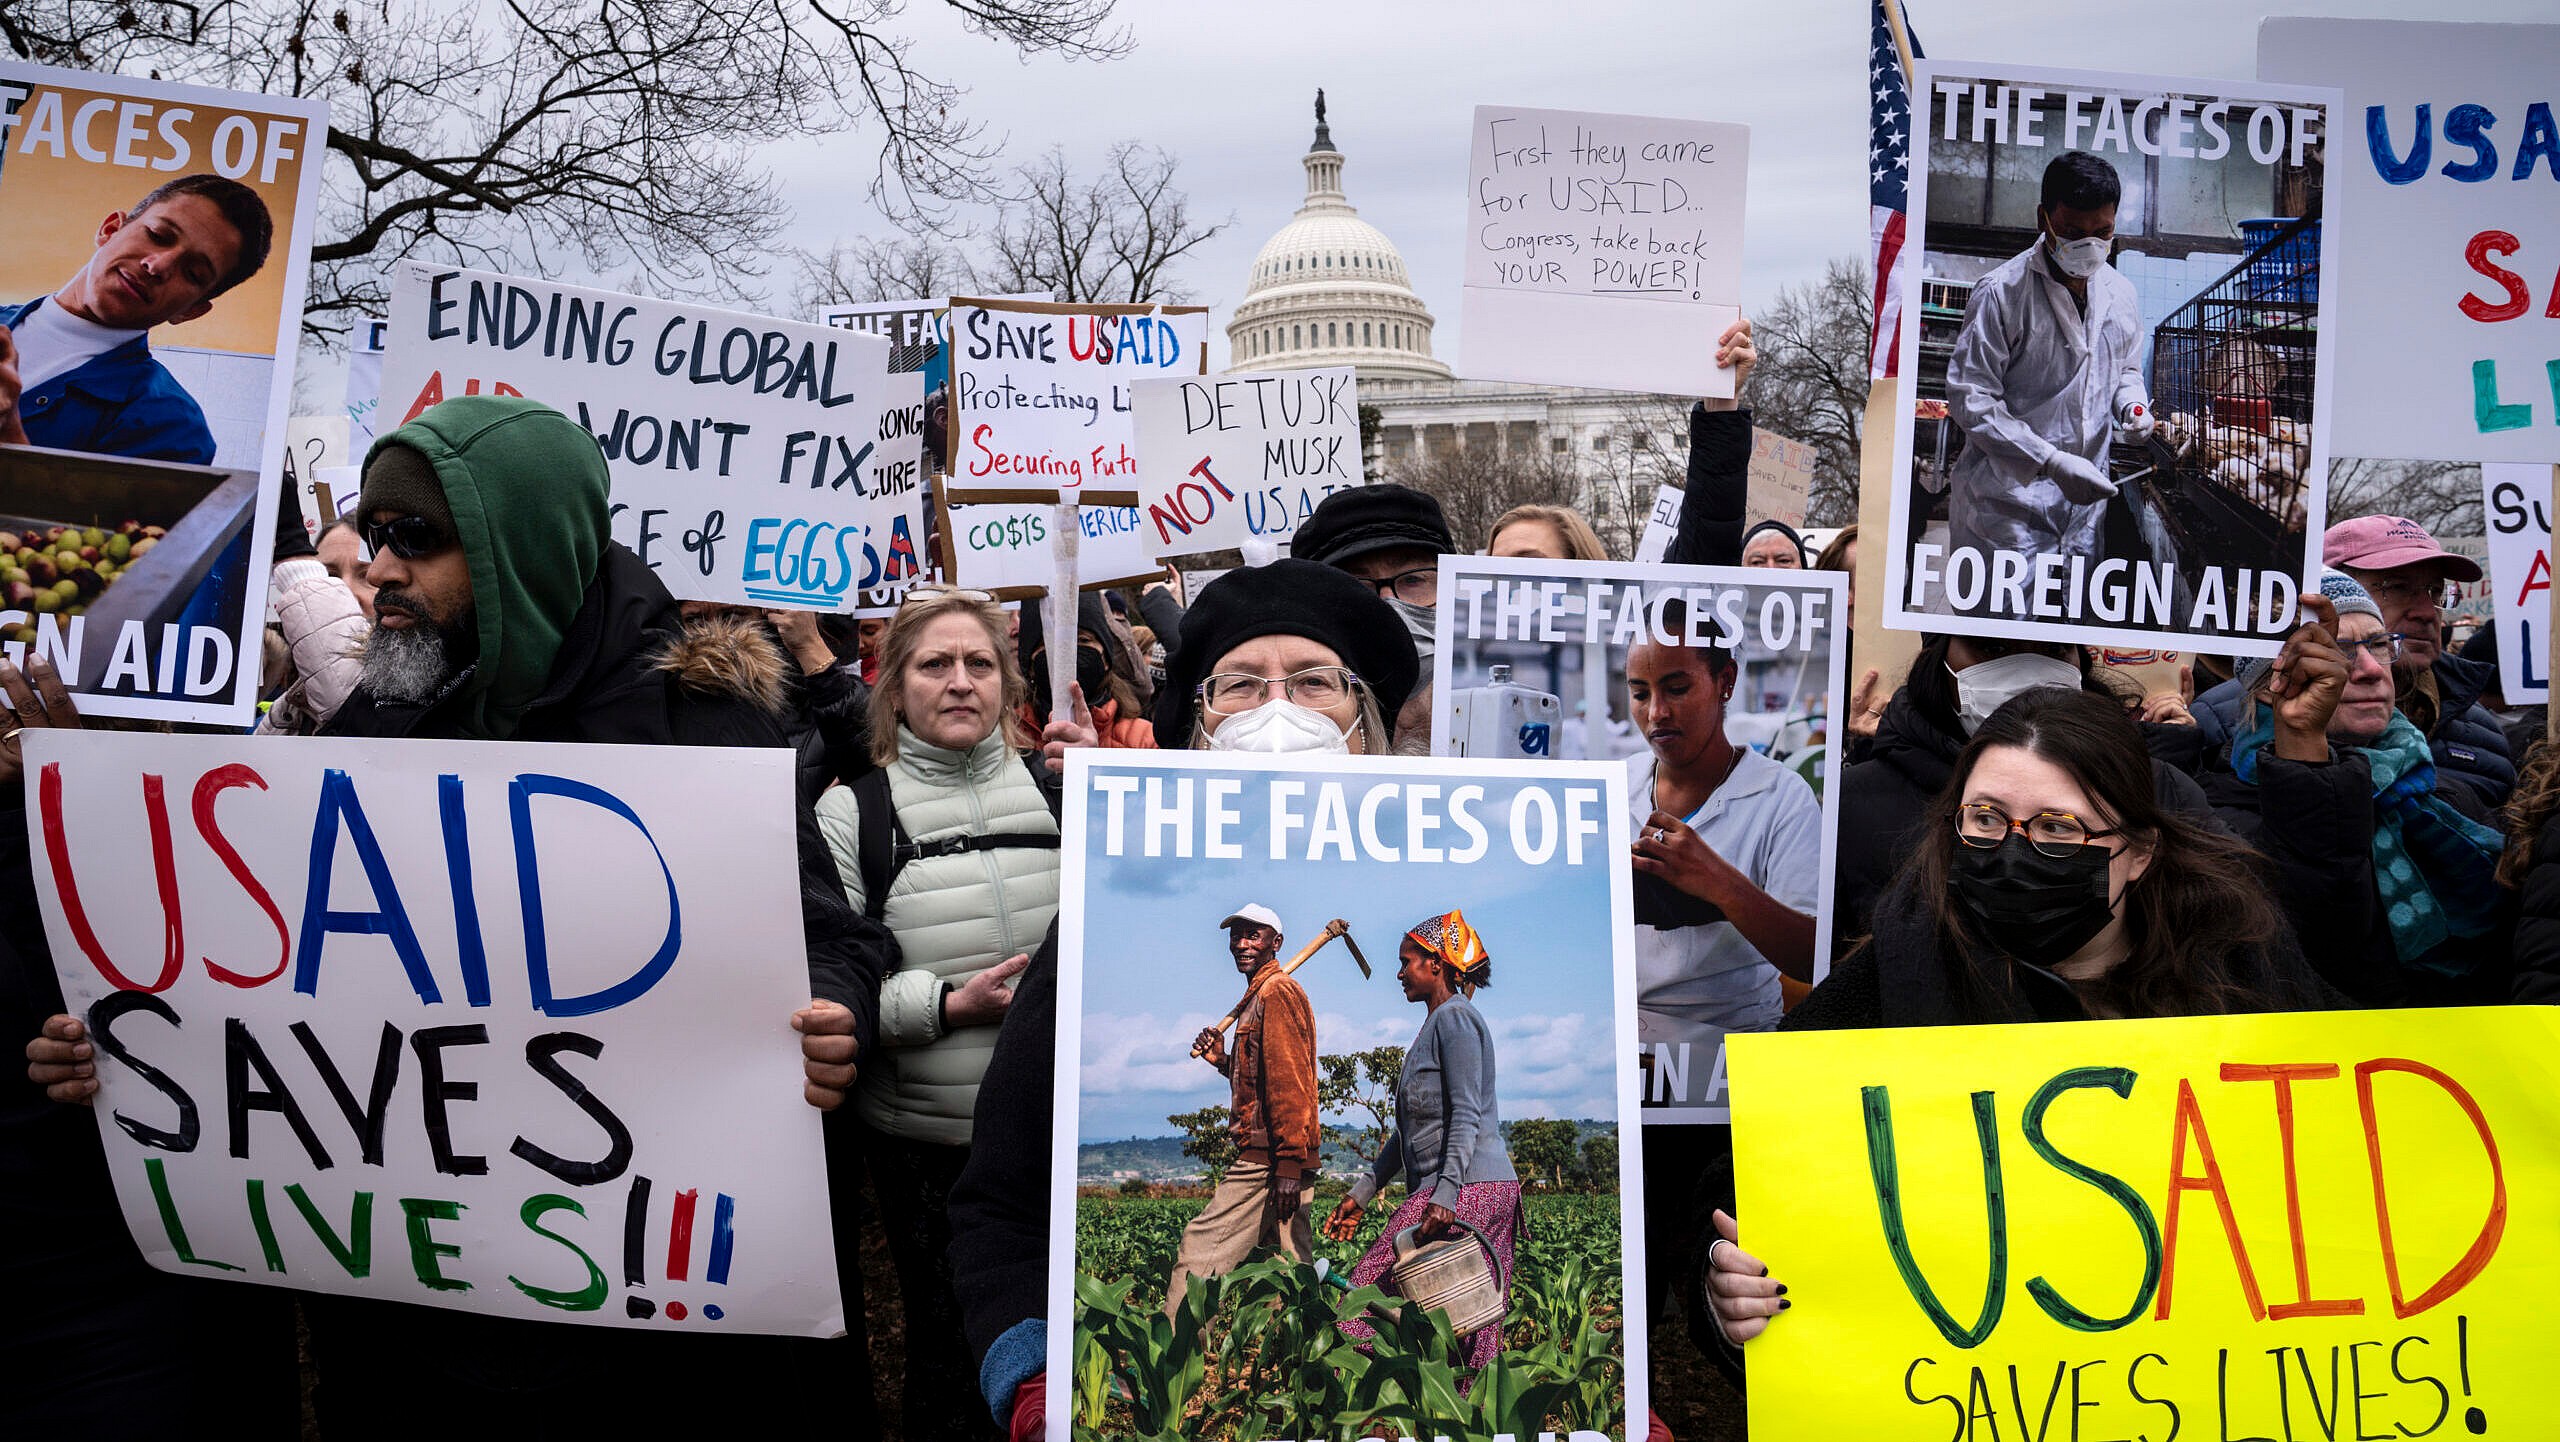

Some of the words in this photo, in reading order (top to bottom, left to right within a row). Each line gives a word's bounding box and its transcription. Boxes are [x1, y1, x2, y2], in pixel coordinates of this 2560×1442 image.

[0, 85, 194, 172] FACES
[211, 115, 300, 184] OF
[1490, 119, 1552, 173] First
[1569, 126, 1626, 185] they
[1641, 141, 1715, 164] came
[1936, 81, 2045, 147] THE
[2064, 91, 2231, 161] FACES
[2247, 105, 2319, 167] OF
[2365, 102, 2560, 186] USA
[1480, 177, 1528, 216] for
[1549, 176, 1703, 215] USAID...
[1480, 222, 1580, 259] Congress,
[1590, 224, 1639, 252] take
[1648, 227, 1709, 260] back
[1494, 260, 1567, 284] YOUR
[1592, 257, 1702, 300] POWER!
[428, 271, 638, 366] ENDING
[654, 315, 854, 408] GLOBAL
[967, 309, 1057, 364] SAVE
[1068, 315, 1181, 368] USAID
[879, 404, 924, 441] ONG
[959, 372, 1099, 427] Protecting
[1180, 374, 1358, 434] DETUSK
[577, 401, 751, 476] WON'T
[779, 431, 875, 497] FIX
[869, 460, 916, 500] URE
[969, 424, 1083, 488] Securing
[1264, 436, 1347, 480] MUSK
[968, 514, 1046, 550] CO$TS
[1148, 456, 1236, 545] NOT
[682, 509, 727, 577] of
[742, 517, 859, 595] EGGS
[1459, 579, 1567, 642] THE
[1585, 583, 1745, 650] FACES
[1759, 591, 1827, 651] OF
[1910, 542, 2174, 626] FOREIGN
[2190, 565, 2298, 634] AID
[101, 619, 233, 697] AID
[1094, 776, 1242, 859] THE
[1269, 780, 1489, 863] FACES
[1509, 785, 1599, 865] OF
[38, 761, 683, 1017] USAID
[88, 989, 634, 1186] SAVES
[143, 1158, 736, 1321] LIVES!!!
[1860, 1056, 2508, 1349] USAID
[1904, 1353, 2181, 1442] SAVES
[2218, 1315, 2488, 1442] LIVES!
